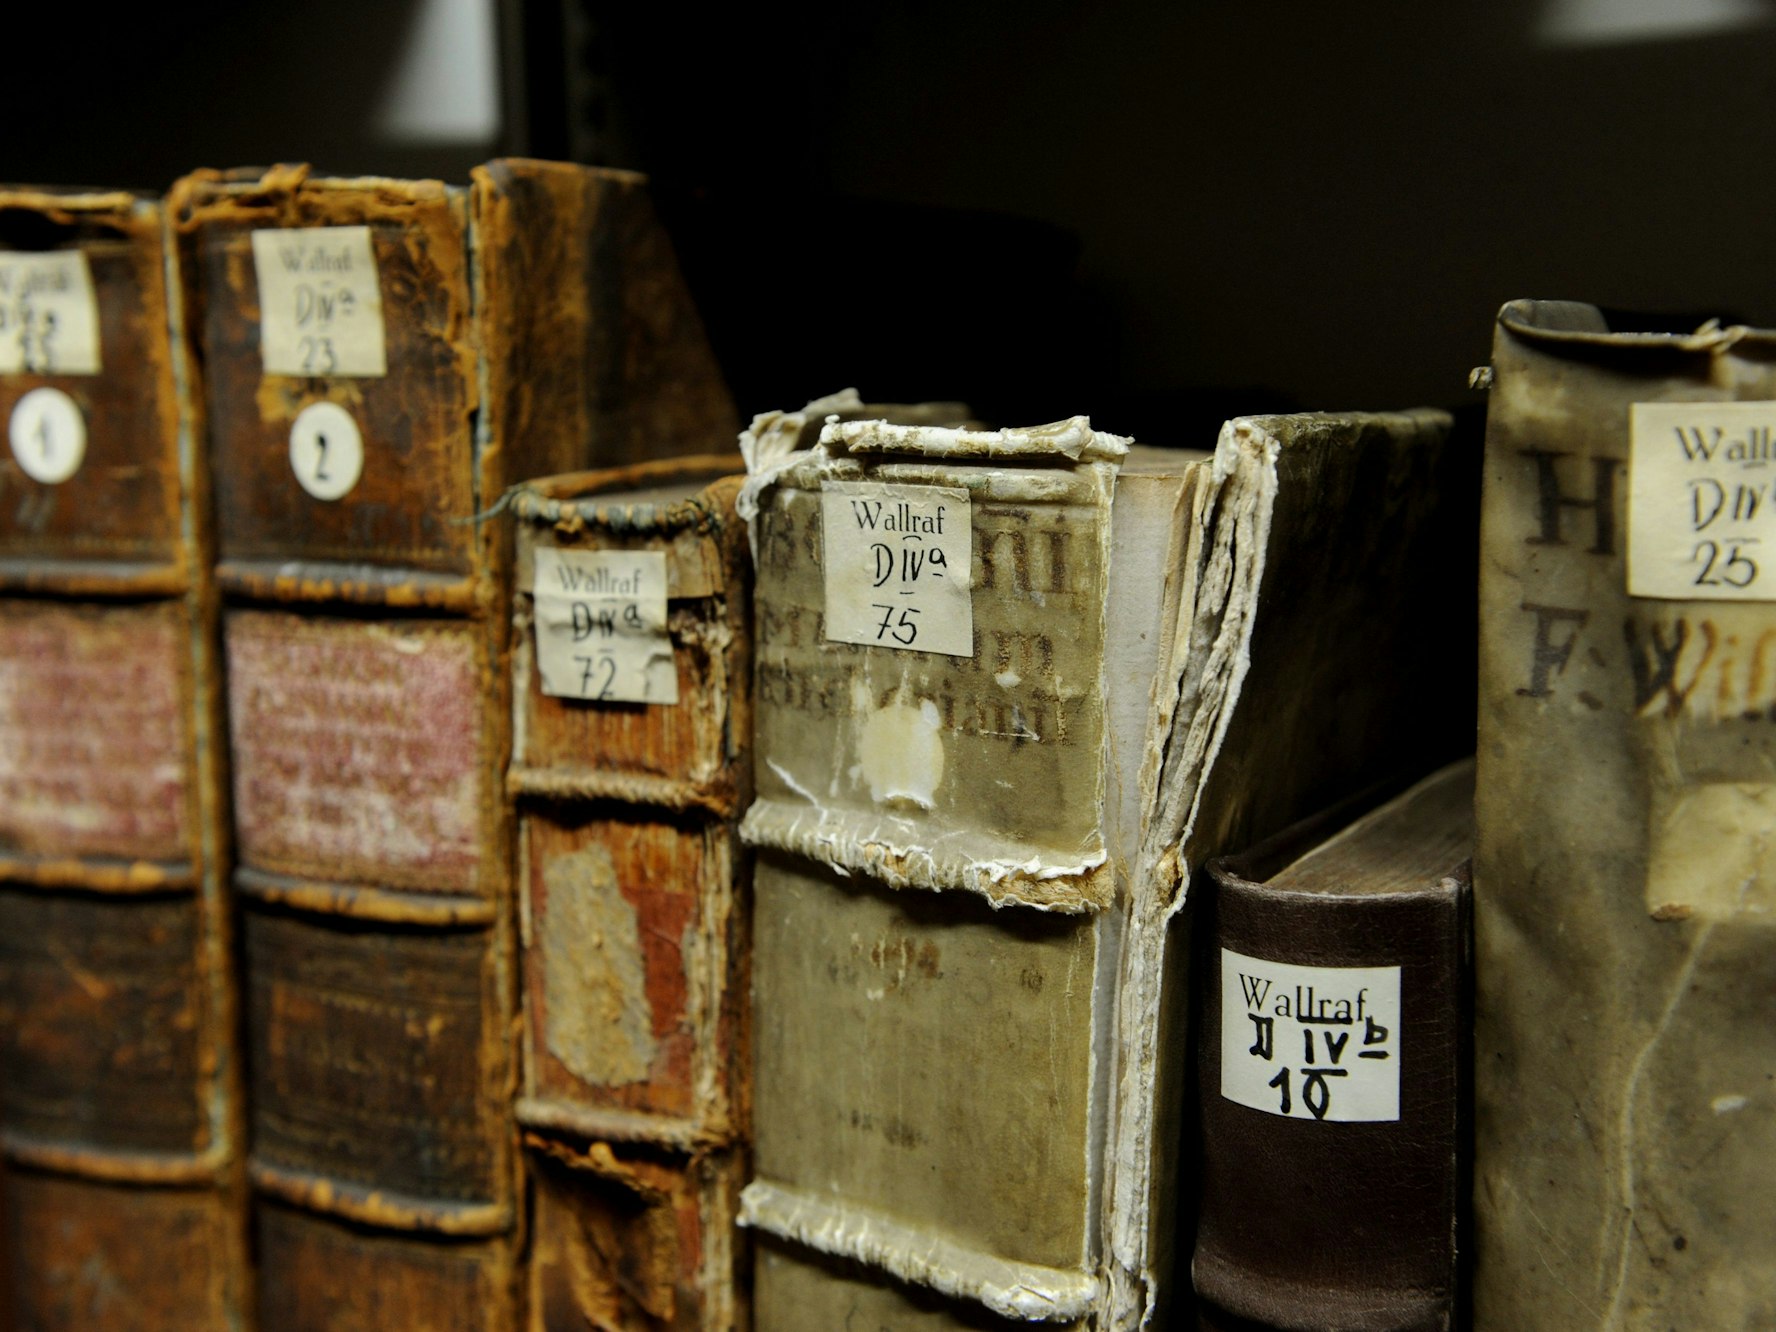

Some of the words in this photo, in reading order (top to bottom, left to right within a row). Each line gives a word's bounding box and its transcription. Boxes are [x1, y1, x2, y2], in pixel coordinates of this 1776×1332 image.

[314, 431, 329, 481] 2
[1675, 426, 1776, 462] Wall
[850, 500, 946, 535] Wallraf
[558, 565, 643, 594] Wallraf
[1693, 540, 1759, 588] 25
[871, 603, 922, 645] 75
[573, 655, 618, 701] 72
[1238, 972, 1369, 1022] Wallraf
[1268, 1066, 1331, 1121] 10
